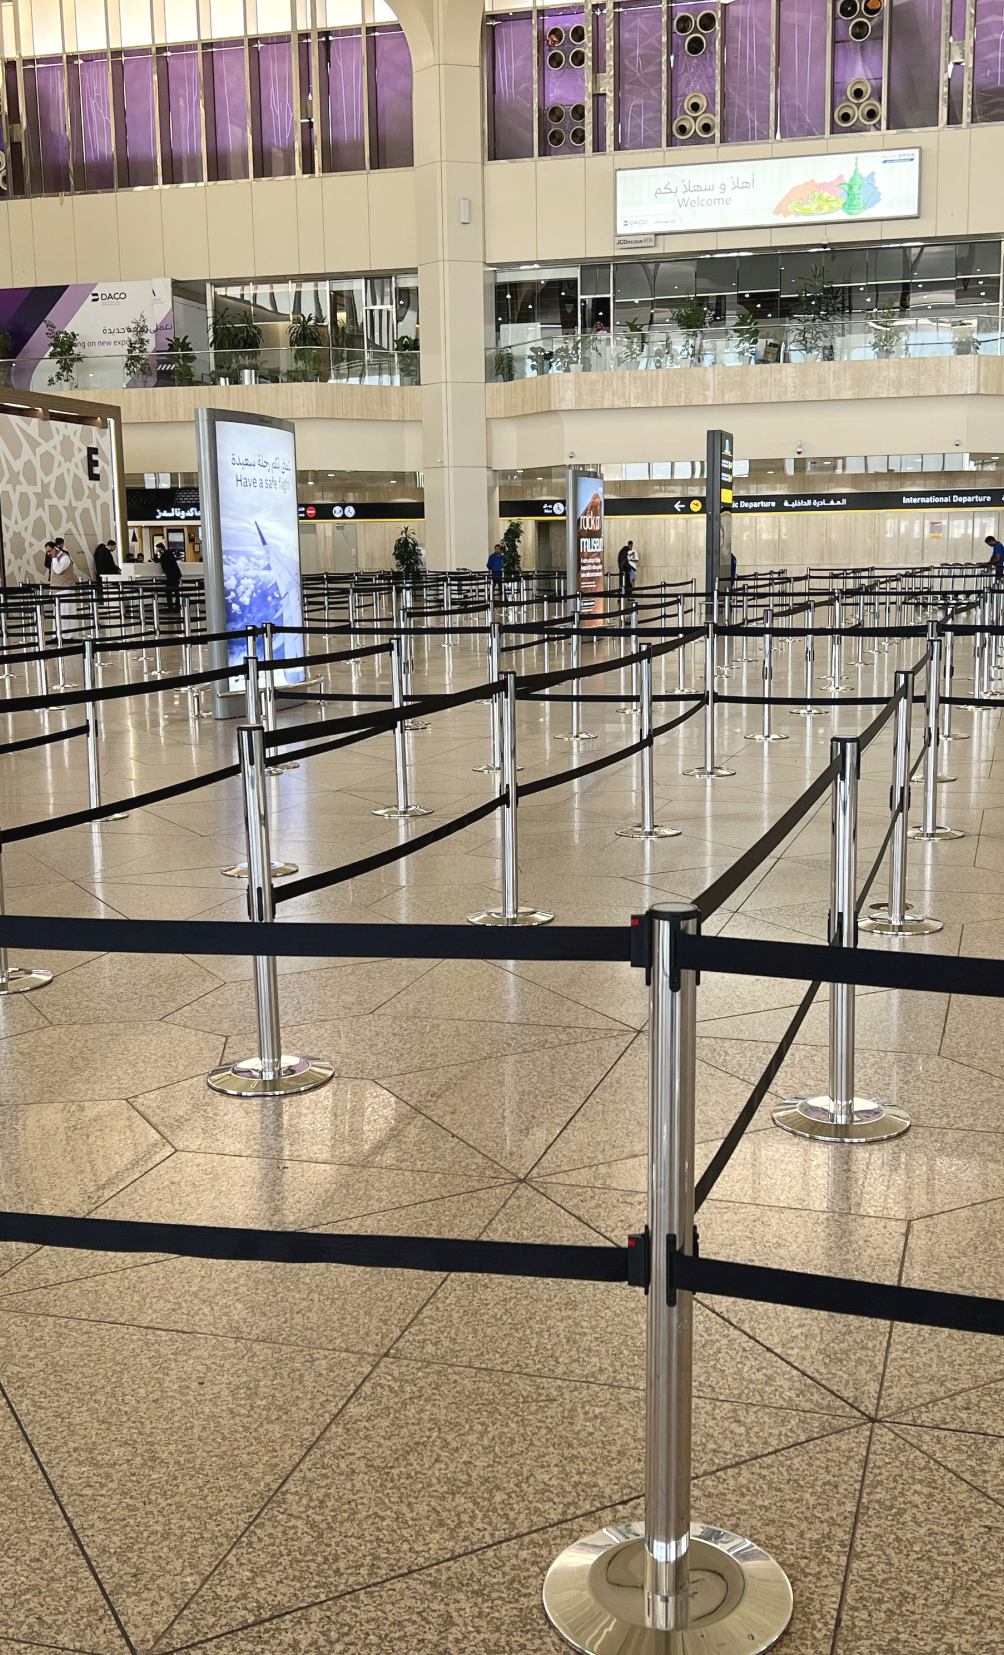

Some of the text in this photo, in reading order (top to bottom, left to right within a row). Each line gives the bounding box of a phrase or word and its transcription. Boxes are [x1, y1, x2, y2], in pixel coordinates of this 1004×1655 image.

[654, 181, 678, 199] بكم
[719, 183, 726, 194] و
[677, 196, 732, 209] Welcome
[101, 292, 127, 301] DACO
[87, 447, 101, 482] E
[231, 453, 256, 470] سعيدة
[235, 474, 258, 488] Have
[259, 478, 264, 488] a
[265, 476, 278, 490] safe
[739, 499, 776, 509] Departure
[783, 498, 847, 509] المغادرة الداخلية
[902, 495, 951, 504] International
[952, 494, 992, 504] Departure
[580, 510, 596, 530] rock
